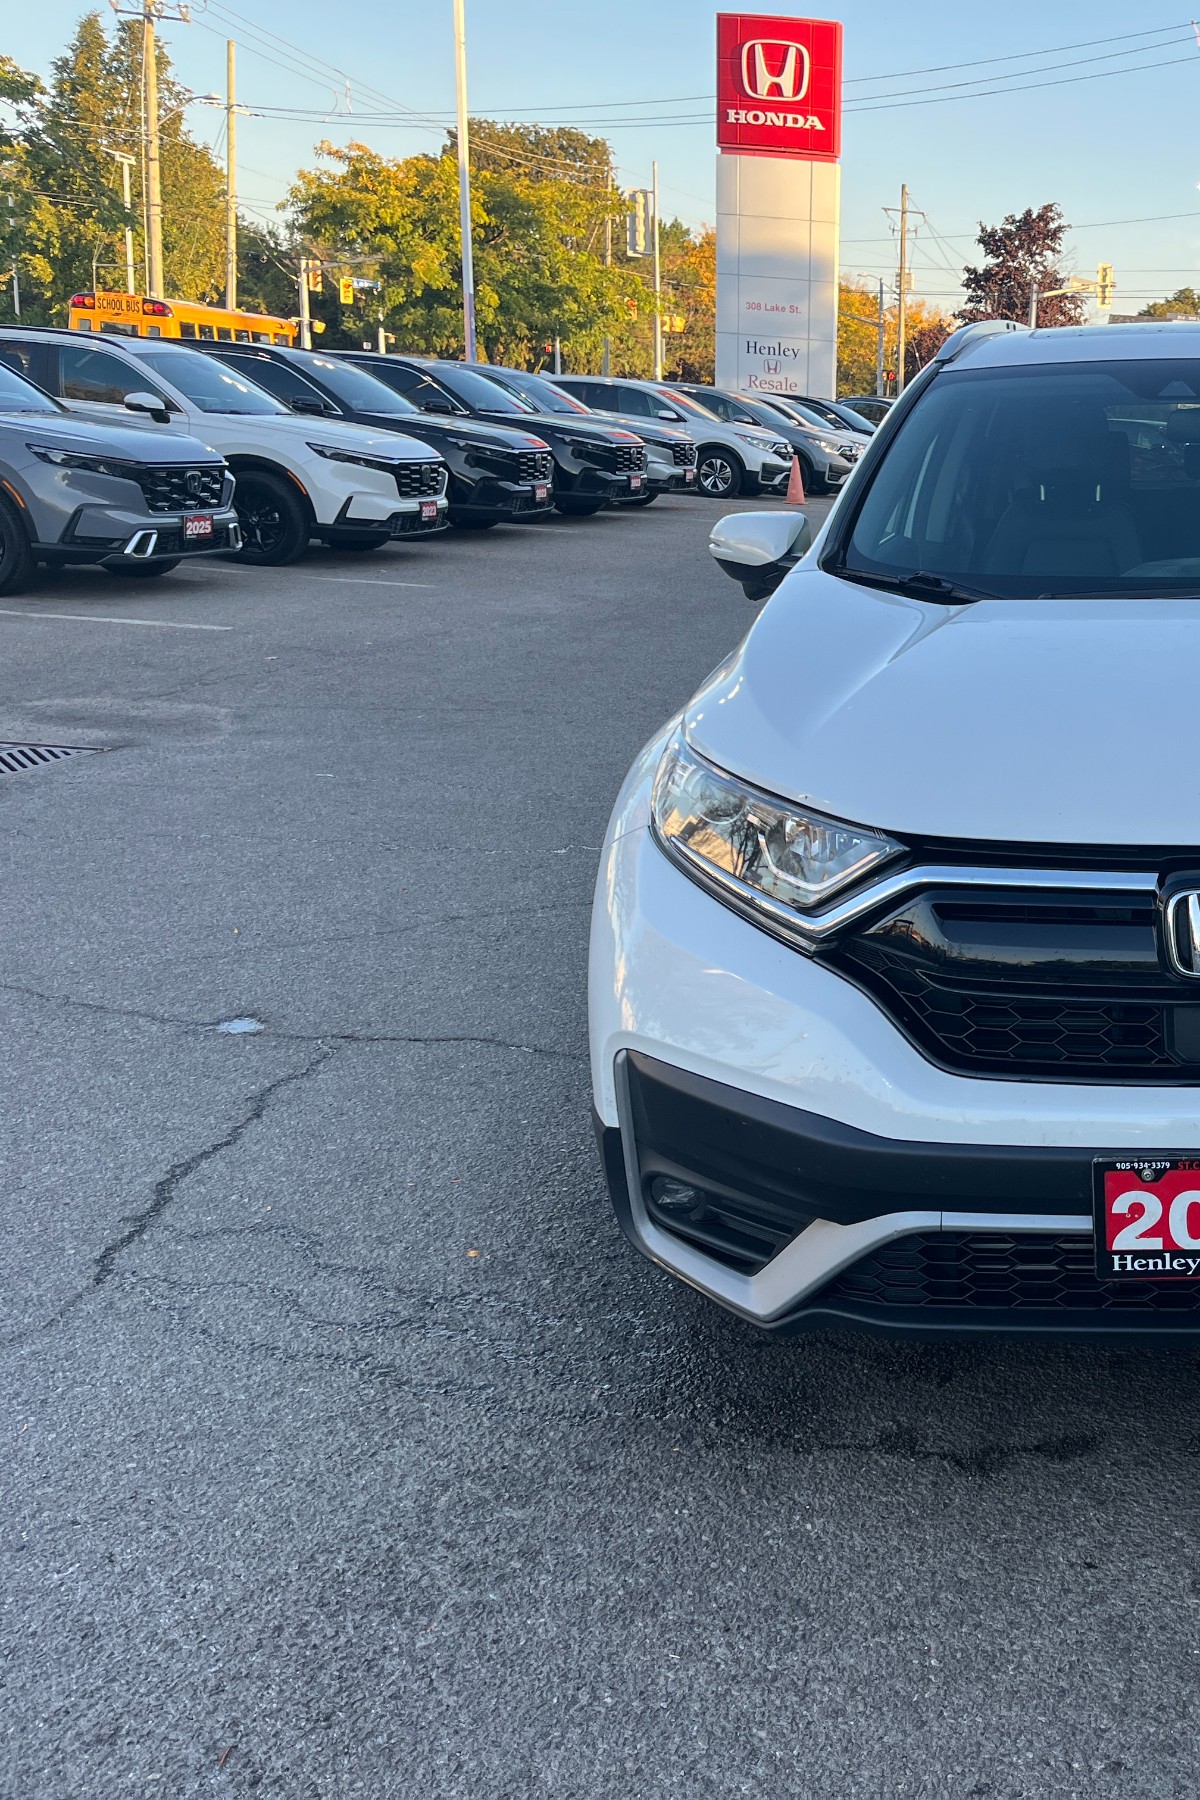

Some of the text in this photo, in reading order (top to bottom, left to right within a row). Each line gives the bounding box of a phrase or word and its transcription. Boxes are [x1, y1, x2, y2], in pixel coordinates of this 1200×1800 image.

[726, 109, 826, 131] HONDA
[97, 298, 140, 313] SCHOOL BUS
[745, 301, 802, 314] 308 Lake St.
[746, 340, 800, 360] Henley
[748, 374, 798, 392] Resale
[186, 520, 212, 535] 2025
[1115, 1161, 1171, 1170] 905-934-3379
